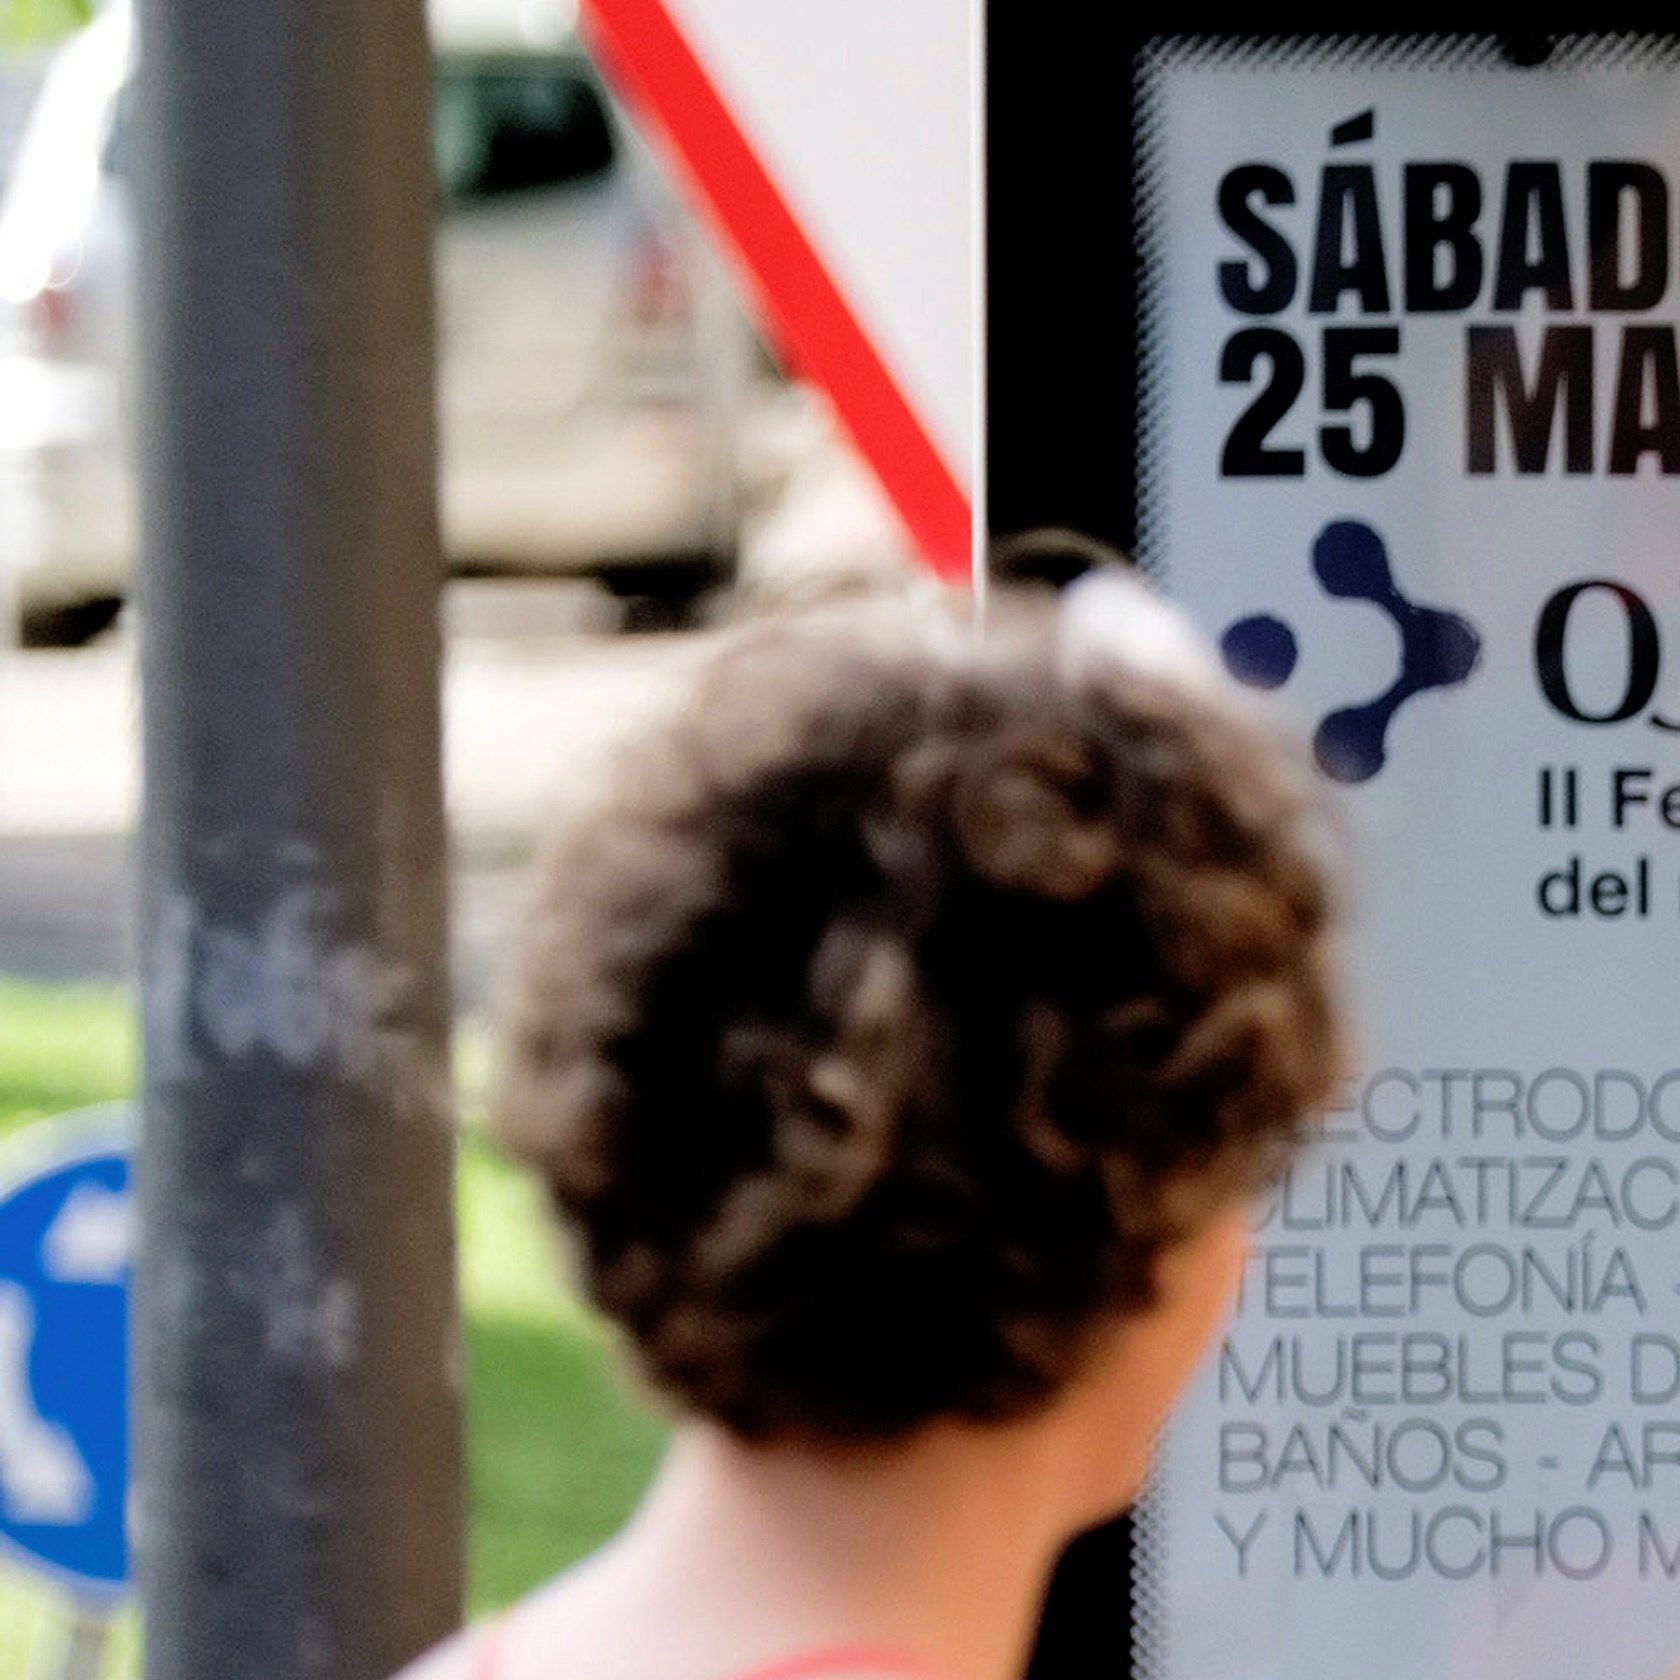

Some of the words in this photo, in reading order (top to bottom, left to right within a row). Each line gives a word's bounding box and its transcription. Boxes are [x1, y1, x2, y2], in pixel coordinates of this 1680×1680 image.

[1218, 324, 1406, 479] 25
[1540, 768, 1577, 827] II
[1537, 857, 1650, 918] del
[1217, 1331, 1603, 1407] MUEBLES
[1218, 1408, 1508, 1494] BAÑOS
[1215, 1511, 1268, 1577] Y
[1293, 1505, 1613, 1581] MUCHO
